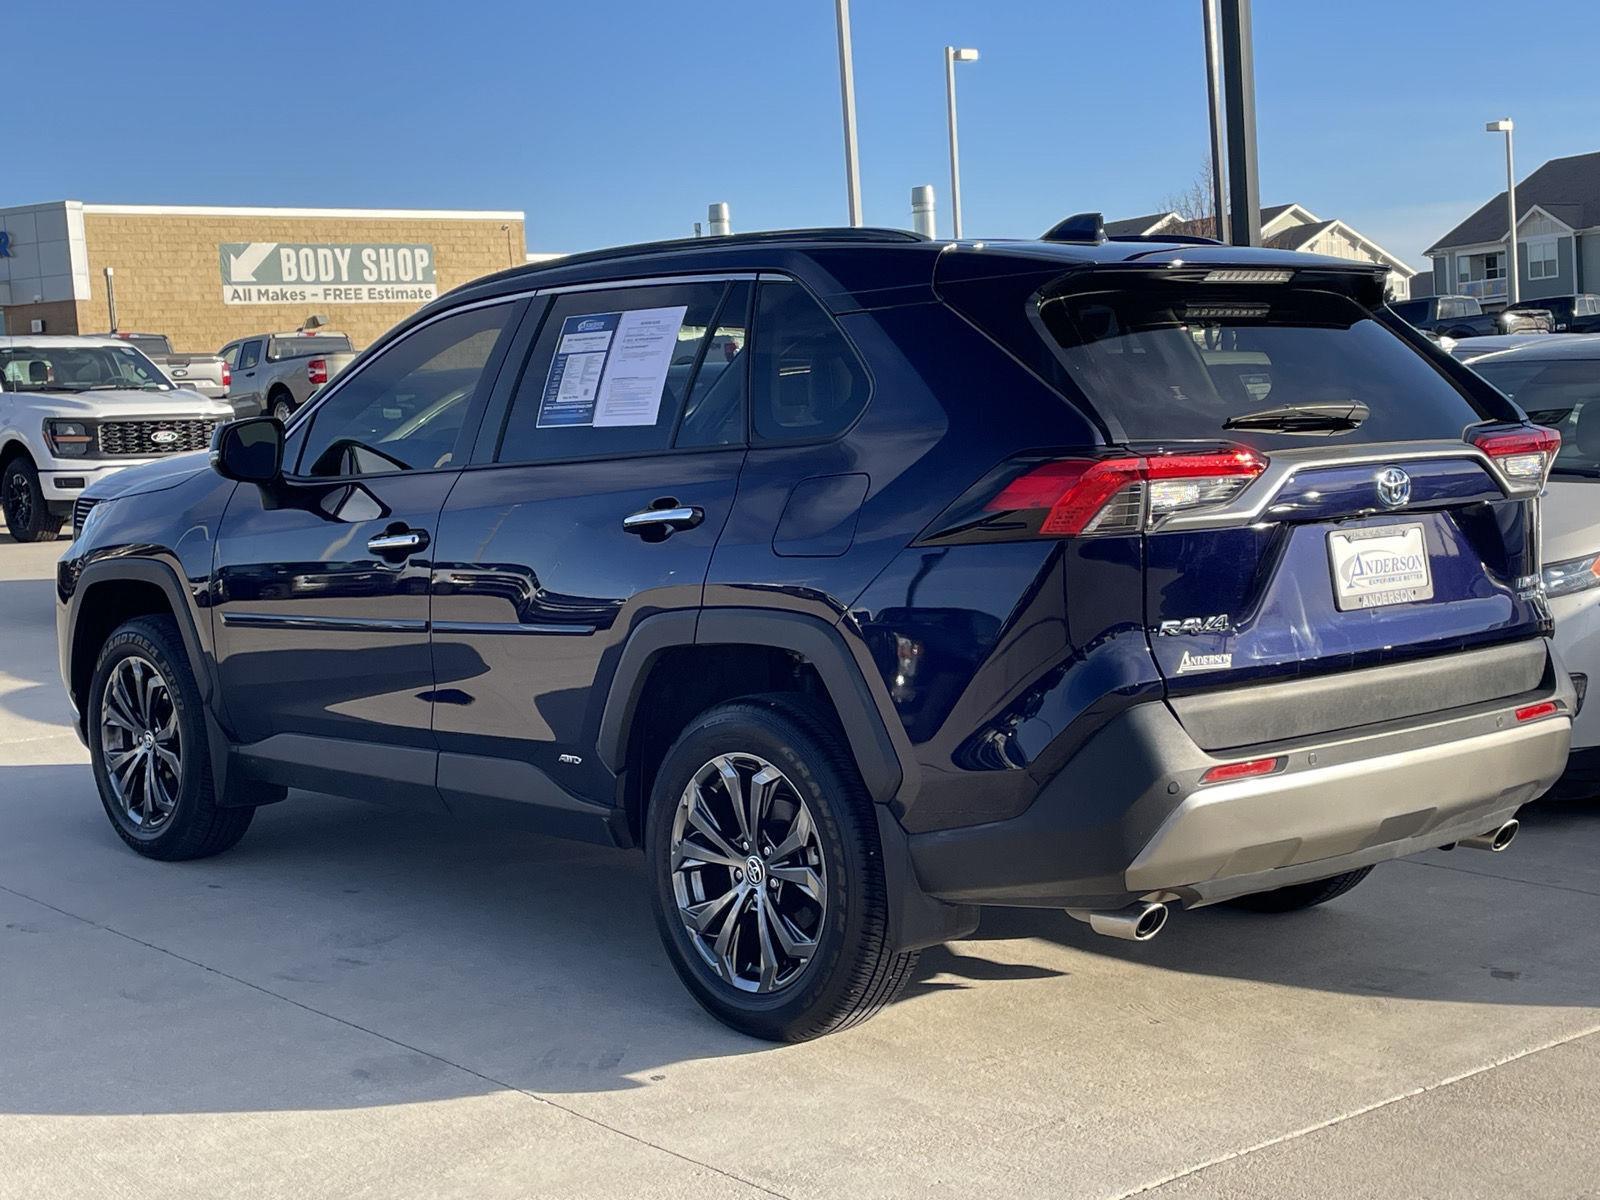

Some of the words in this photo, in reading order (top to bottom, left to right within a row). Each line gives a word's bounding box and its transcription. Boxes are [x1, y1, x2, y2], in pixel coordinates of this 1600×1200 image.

[280, 248, 350, 282] BODY
[362, 247, 429, 281] SHOP
[231, 288, 251, 301] All
[257, 288, 306, 301] Makes
[323, 288, 363, 300] FREE
[368, 287, 432, 300] Estimate
[1346, 553, 1423, 588] ANDERSON
[1361, 589, 1415, 607] ANDERSON
[1158, 614, 1229, 636] RAV4
[1176, 650, 1233, 673] ANDERSON
